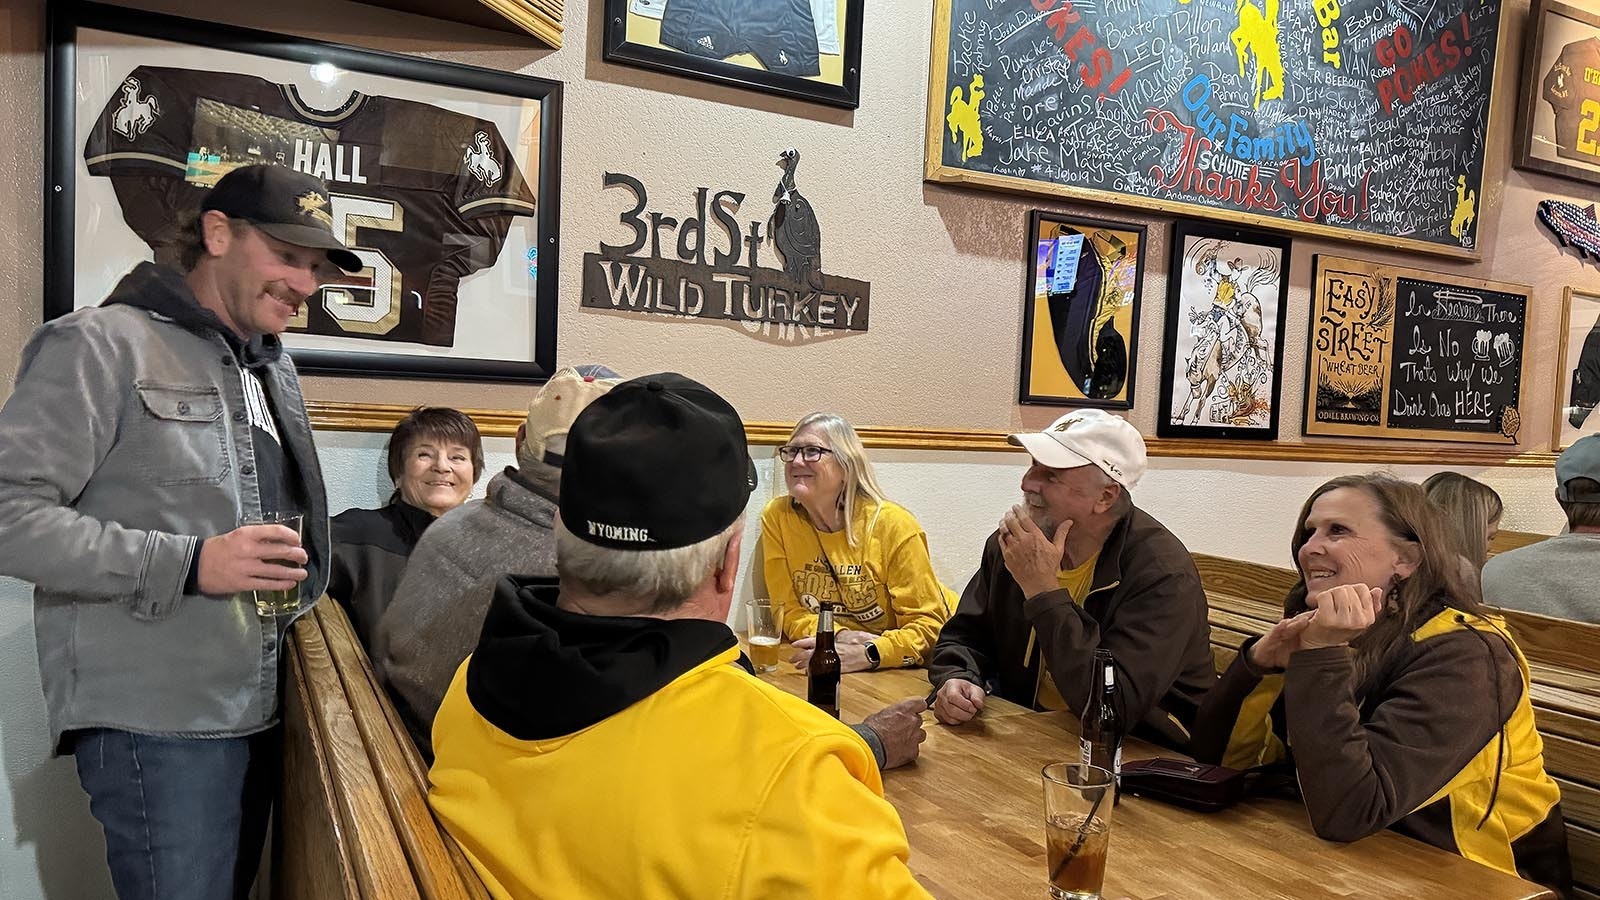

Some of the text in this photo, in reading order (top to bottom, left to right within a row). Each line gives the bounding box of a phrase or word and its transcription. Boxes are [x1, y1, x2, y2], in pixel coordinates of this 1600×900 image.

[1104, 15, 1158, 49] Baxter
[1173, 6, 1222, 35] Dillon
[1376, 26, 1412, 67] GO
[1377, 12, 1473, 116] POKES!
[1182, 74, 1227, 142] Our
[1224, 112, 1316, 167] Family
[293, 138, 367, 184] HALL
[999, 135, 1051, 165] Jake
[1143, 107, 1290, 213] Thanks
[1280, 157, 1370, 222] You!
[600, 260, 860, 328] WILD TURKEY
[1325, 278, 1376, 320] EASY
[1316, 315, 1390, 363] STREET
[1439, 328, 1460, 357] No
[1323, 357, 1379, 378] WHEAT BEER
[1446, 360, 1475, 392] Why
[1481, 365, 1504, 385] We
[1393, 389, 1426, 417] Drink
[1454, 390, 1494, 418] HERE
[587, 520, 650, 542] WYOMING
